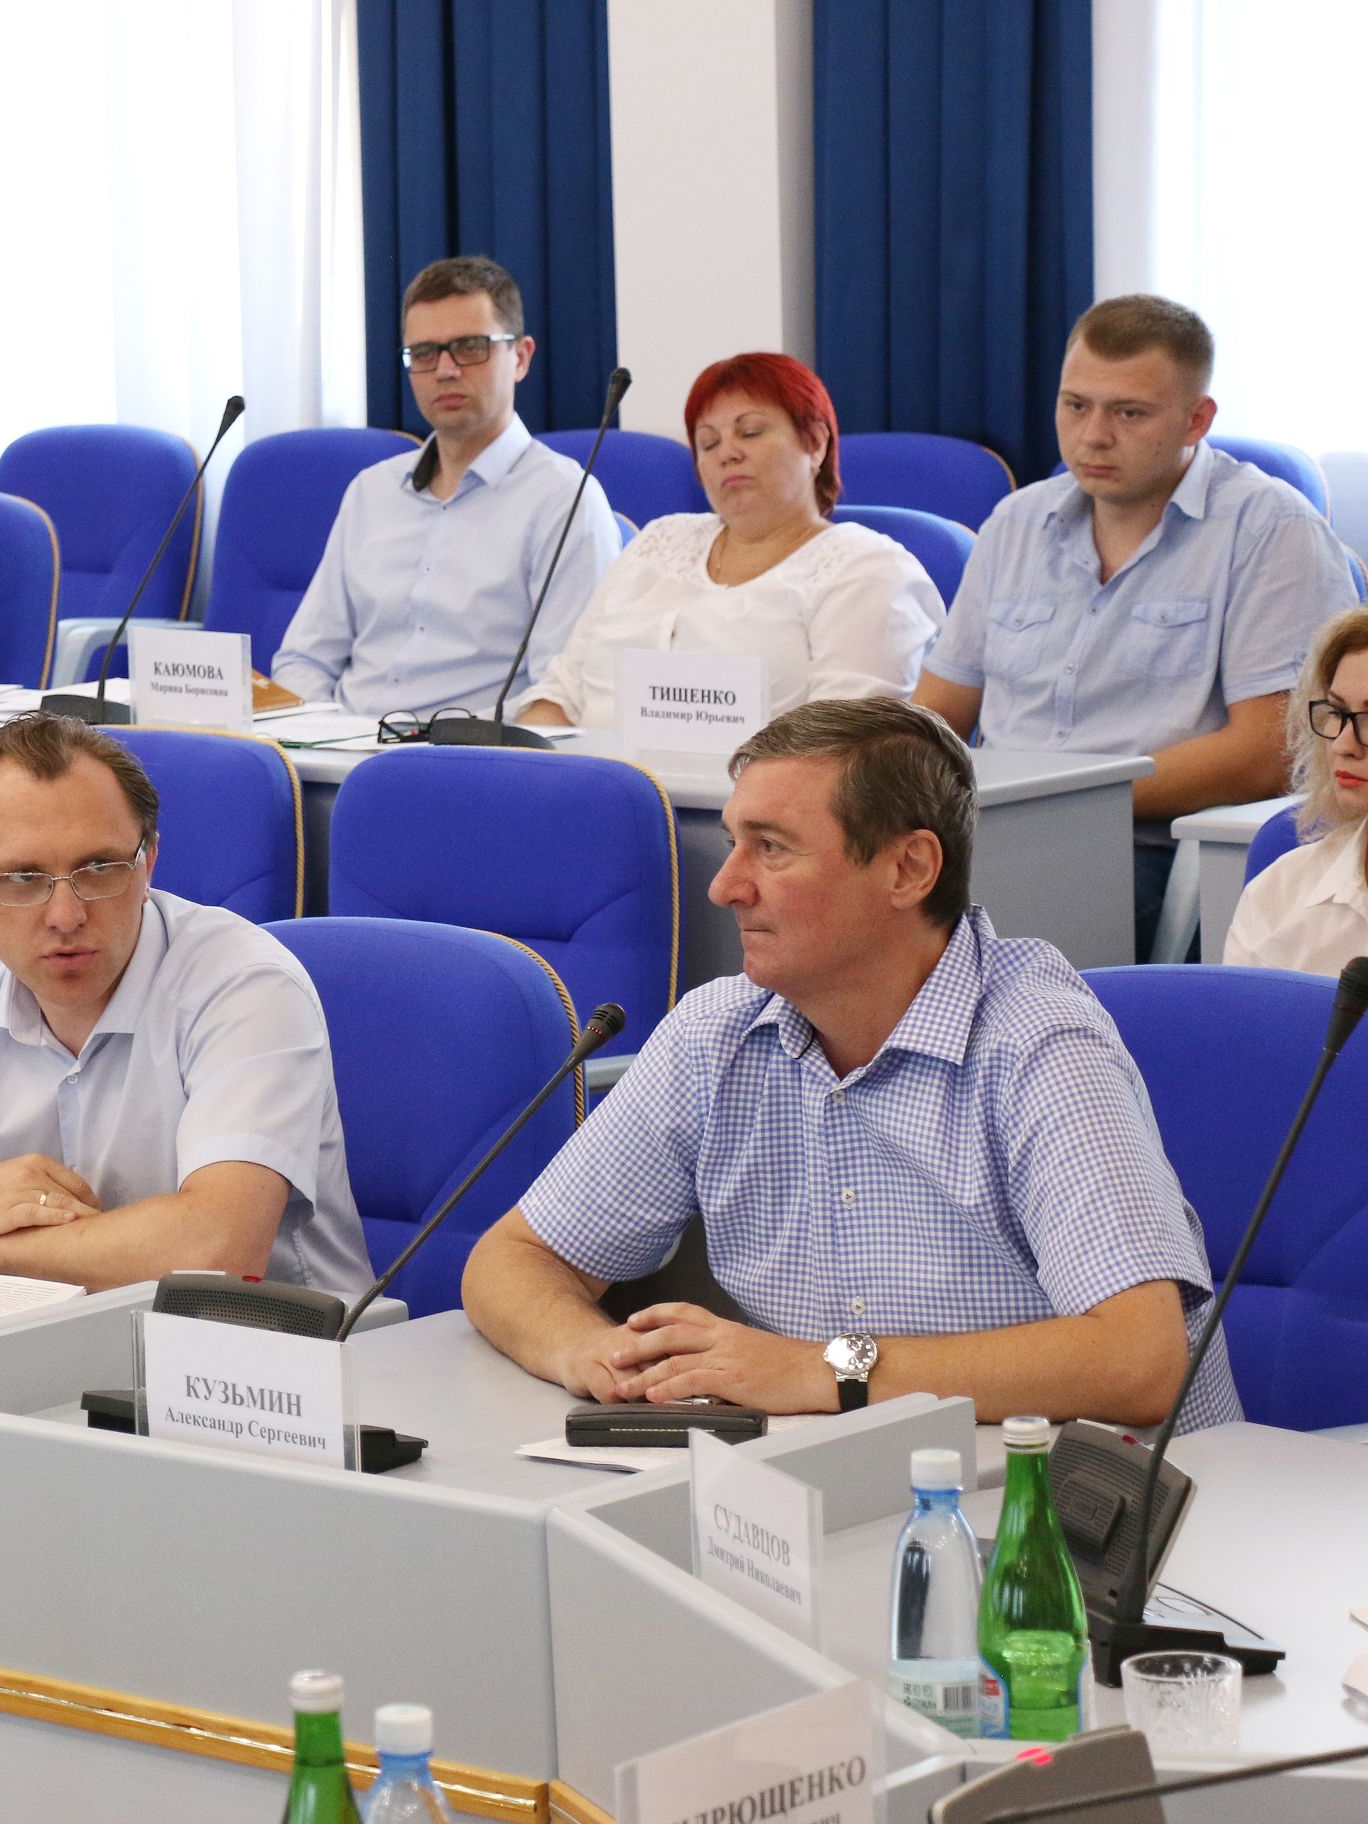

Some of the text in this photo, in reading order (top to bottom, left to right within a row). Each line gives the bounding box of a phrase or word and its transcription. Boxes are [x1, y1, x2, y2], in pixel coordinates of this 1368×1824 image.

[150, 681, 228, 697] Марина Борисовна
[154, 662, 224, 680] КАЮМОВА
[640, 706, 745, 725] Владимир Юрьевич
[649, 685, 736, 706] ТИЩЕНКО
[184, 1375, 302, 1418] КУЗЬМИН
[164, 1406, 326, 1450] Александр Сергеевич
[713, 1504, 791, 1567] СУДАВЦОВ
[707, 1536, 802, 1606] Дмитрий Николаевич
[674, 1756, 866, 1824] РЮЩЕНКО
